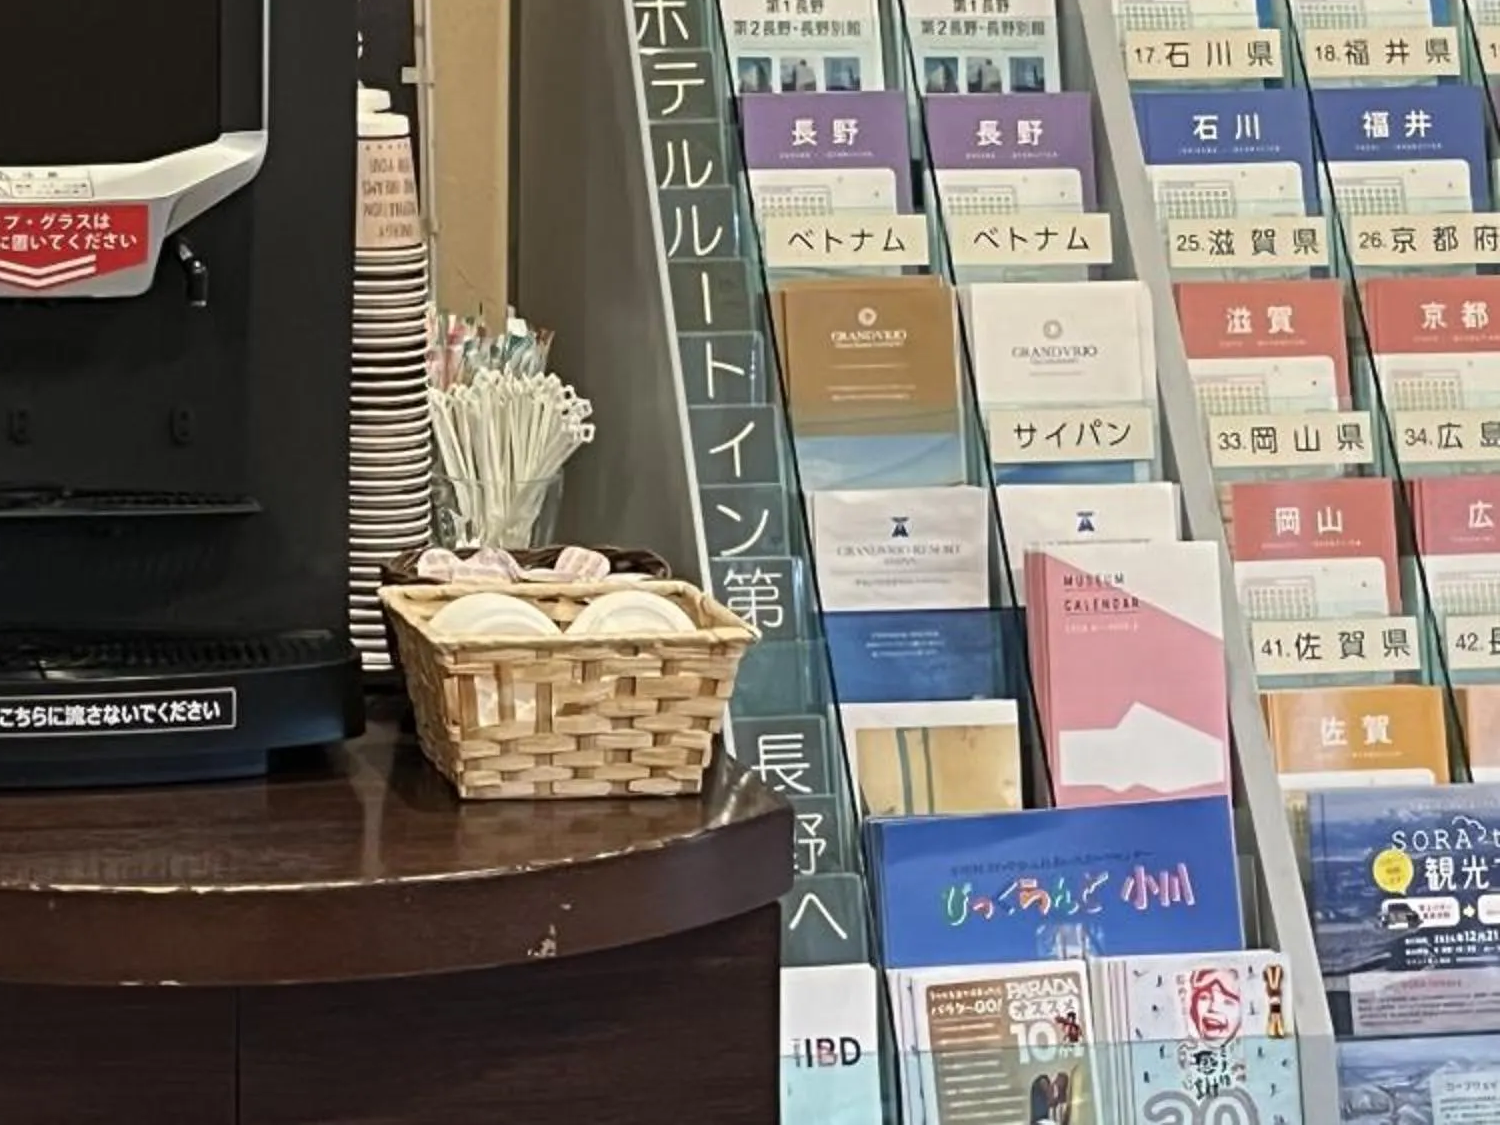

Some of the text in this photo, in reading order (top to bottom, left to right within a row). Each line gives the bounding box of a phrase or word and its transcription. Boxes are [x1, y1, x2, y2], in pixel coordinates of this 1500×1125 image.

[791, 119, 860, 147] 長野
[976, 119, 1044, 147] 長野
[1193, 113, 1261, 141] 石川
[1362, 109, 1432, 140] 福井
[788, 227, 906, 253] ベトナム
[974, 226, 1090, 252] ベトナム
[1226, 306, 1295, 335] 滋賀
[1420, 301, 1490, 331] 京都
[1013, 419, 1131, 449] サイパン
[1275, 506, 1344, 536] 岡山
[1468, 500, 1494, 529] 広
[1063, 573, 1125, 587] MUSEUM
[1063, 597, 1140, 612] CALENDAR
[1320, 714, 1393, 747] 佐賀
[1391, 828, 1473, 852] SORA
[1005, 978, 1079, 999] PARADA
[1009, 1021, 1058, 1065] 10
